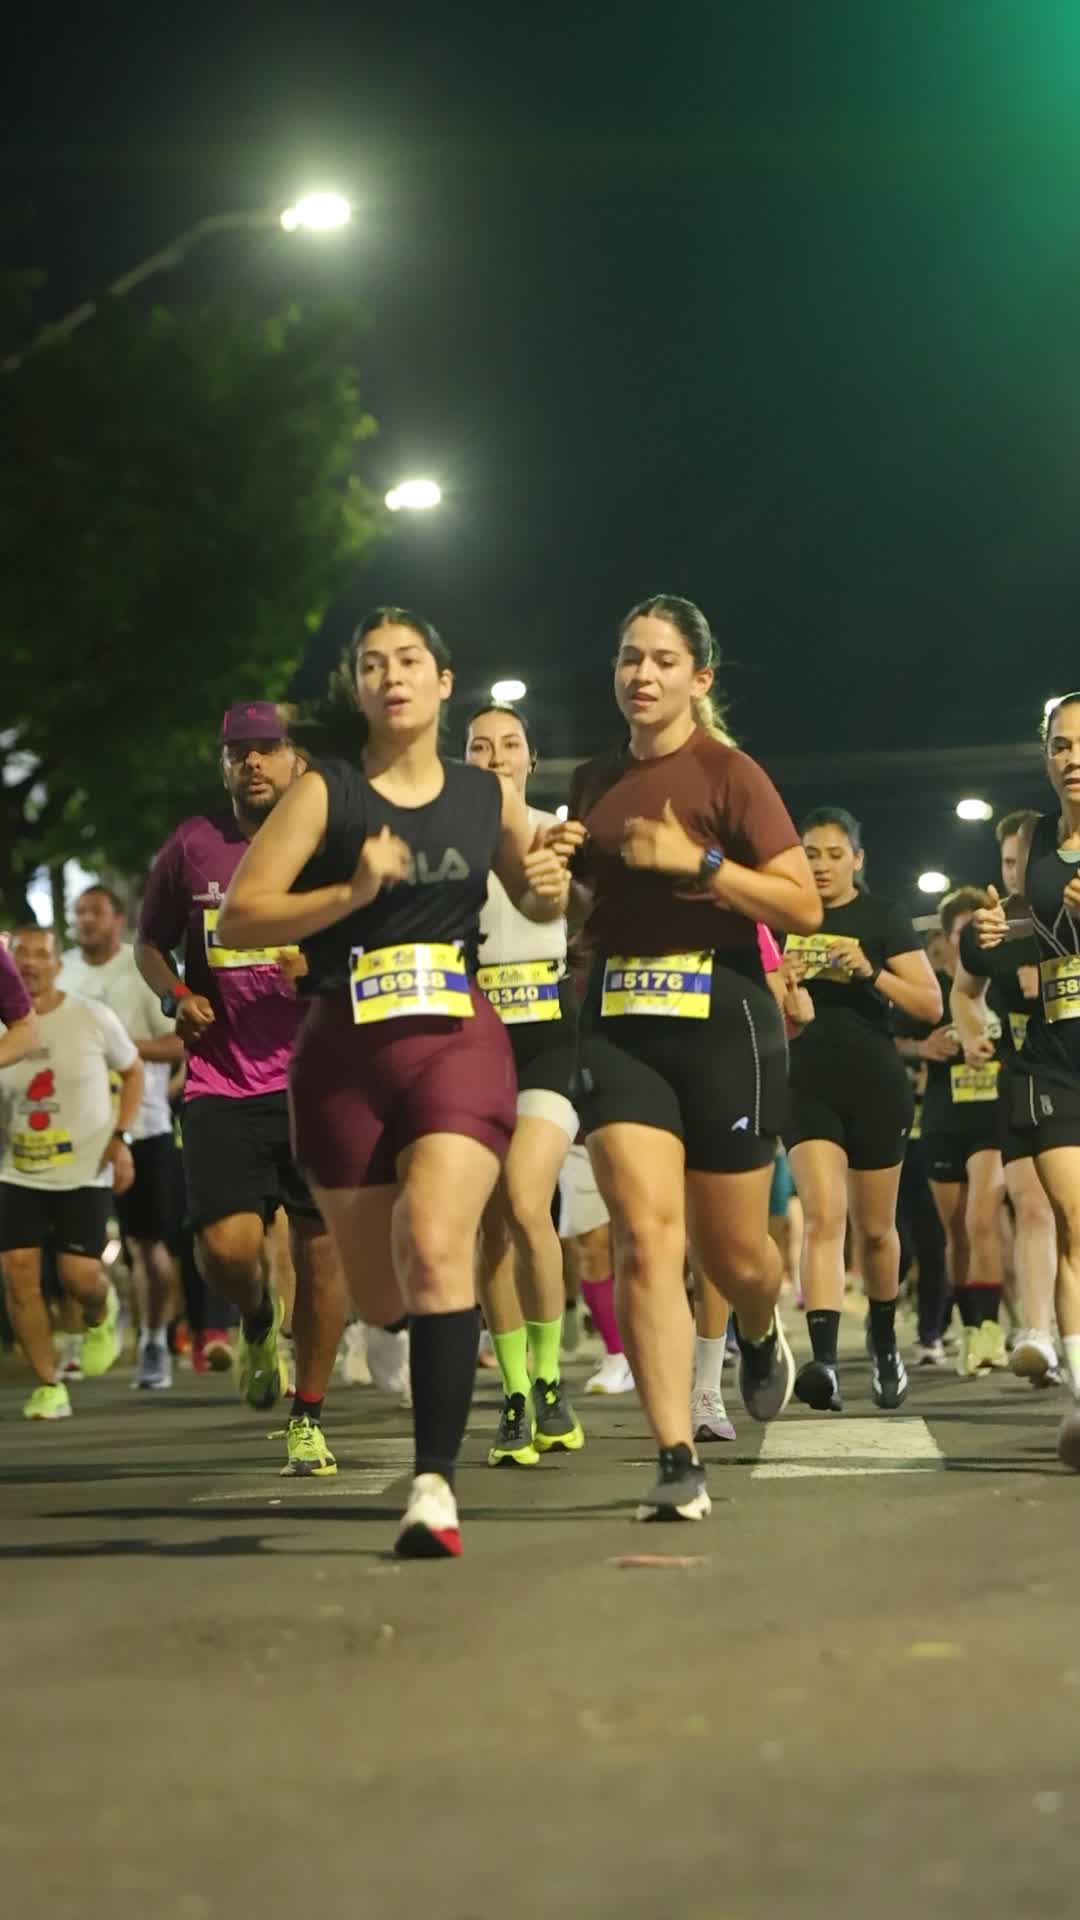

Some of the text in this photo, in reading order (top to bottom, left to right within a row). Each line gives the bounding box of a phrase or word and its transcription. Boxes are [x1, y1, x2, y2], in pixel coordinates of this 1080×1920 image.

[402, 848, 470, 888] ILA
[624, 971, 682, 989] 5176
[1056, 979, 1080, 996] 58
[488, 986, 538, 1004] 6340
